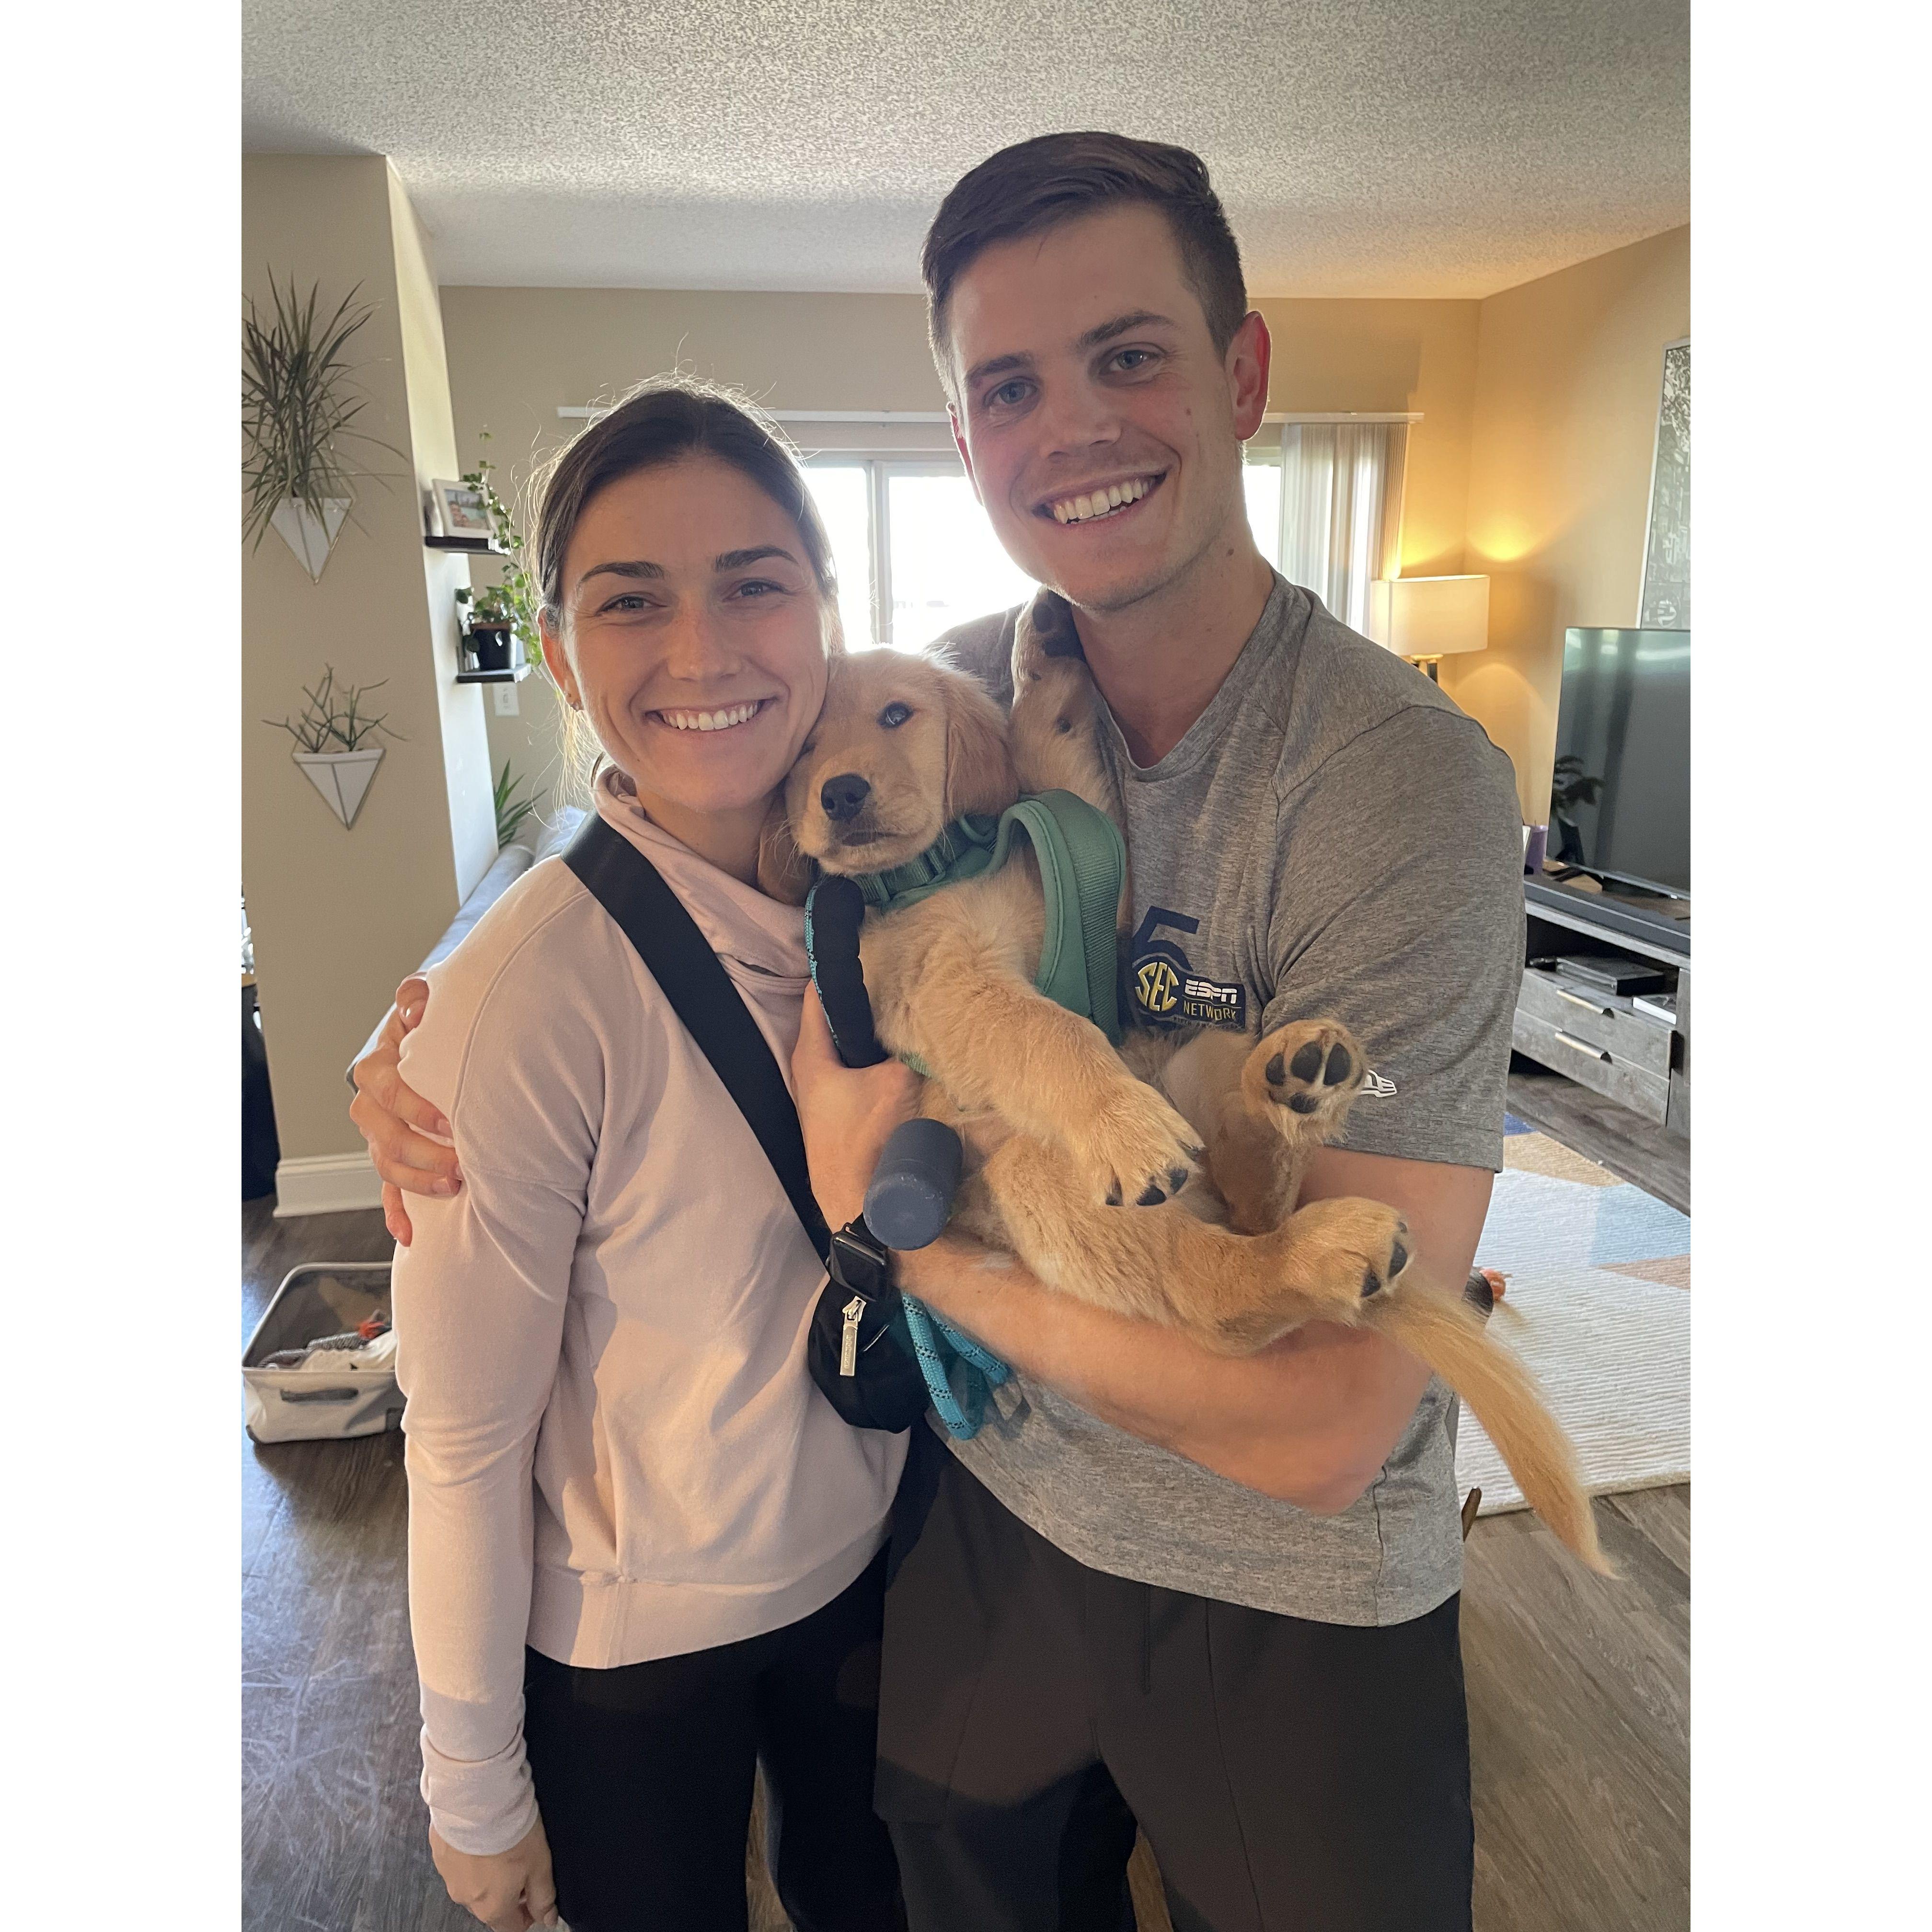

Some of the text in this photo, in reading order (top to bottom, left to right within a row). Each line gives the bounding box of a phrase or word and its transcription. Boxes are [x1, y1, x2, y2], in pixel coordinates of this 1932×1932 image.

[1135, 962, 1179, 1012] SEC
[1184, 979, 1237, 1004] ESPN
[1184, 1002, 1236, 1021] NETWORK
